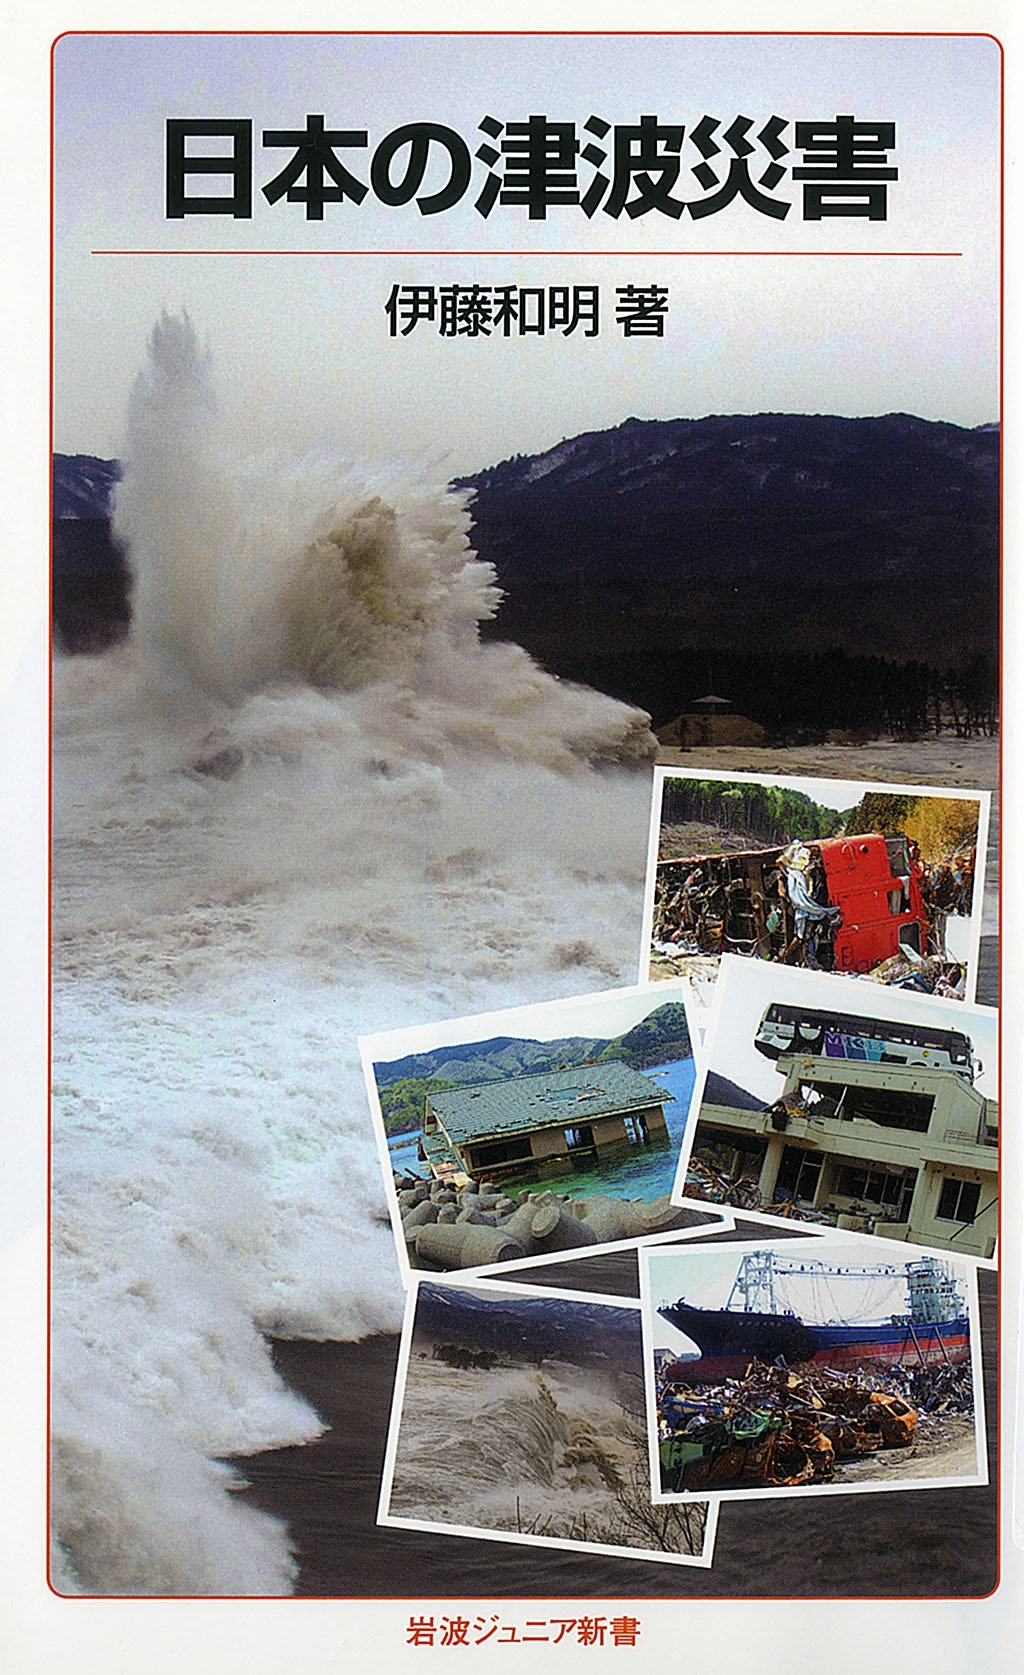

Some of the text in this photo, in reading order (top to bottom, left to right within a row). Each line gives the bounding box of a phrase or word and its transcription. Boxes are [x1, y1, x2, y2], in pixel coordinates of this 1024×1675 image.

[166, 115, 898, 221] 日本の津波災害
[385, 285, 668, 337] 伊藤和明 著
[406, 1614, 641, 1647] 岩波ジュニア新書
